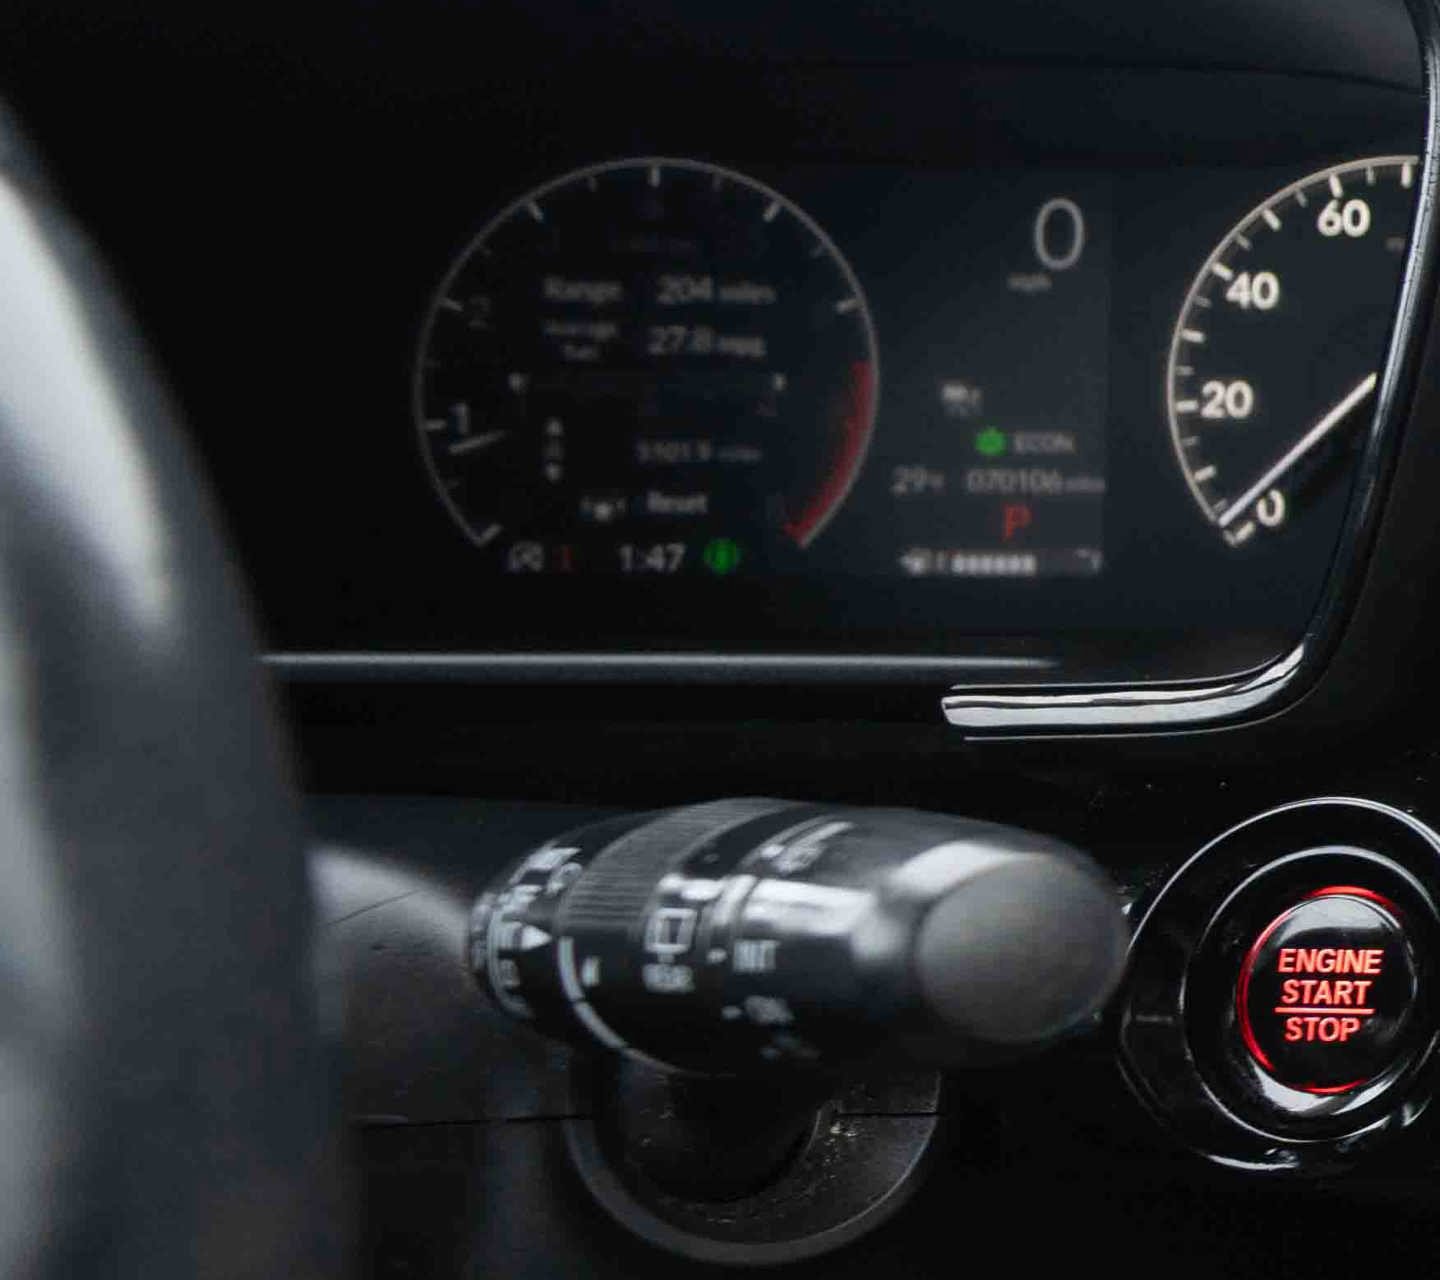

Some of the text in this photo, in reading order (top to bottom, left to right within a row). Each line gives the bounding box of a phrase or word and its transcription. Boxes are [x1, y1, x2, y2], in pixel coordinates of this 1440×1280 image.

[1035, 198, 1085, 271] 0
[1317, 199, 1371, 238] 60
[1225, 272, 1280, 311] 40
[1201, 380, 1255, 419] 20
[1004, 504, 1033, 540] P
[1256, 489, 1287, 527] 0
[1278, 947, 1382, 976] ENGINE
[1283, 979, 1372, 1006] START
[1285, 1015, 1360, 1043] STOP
